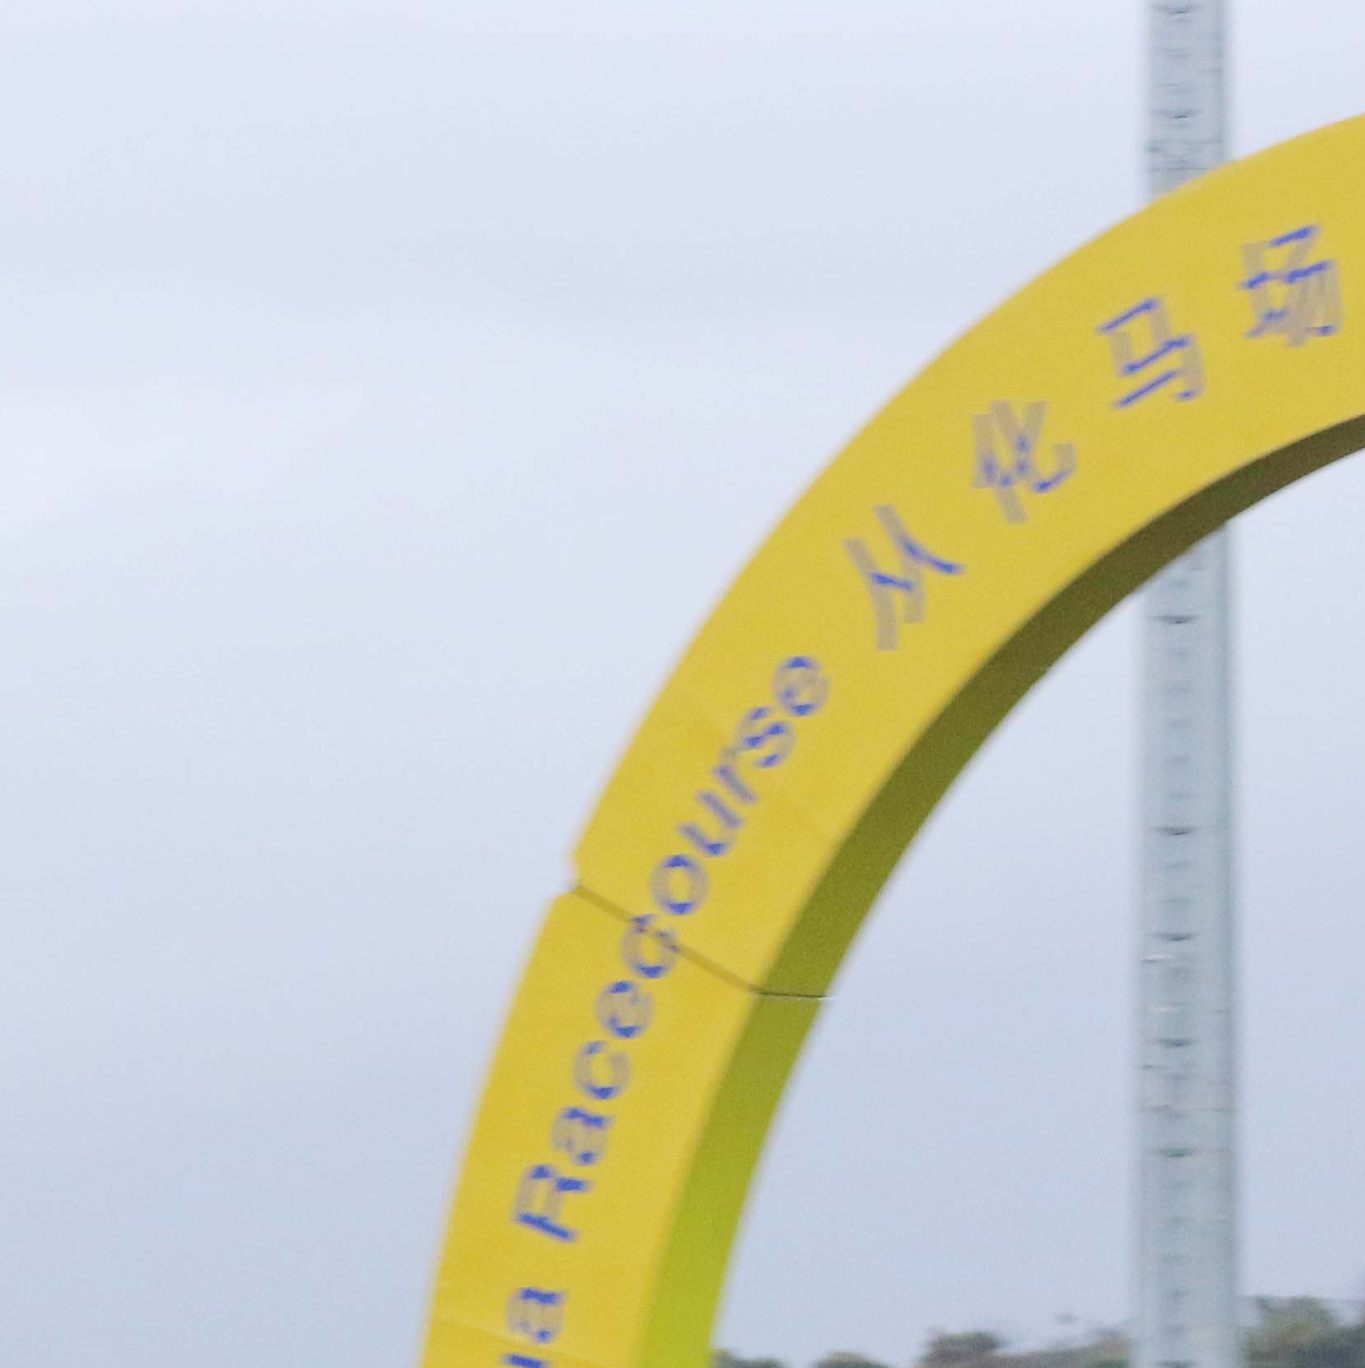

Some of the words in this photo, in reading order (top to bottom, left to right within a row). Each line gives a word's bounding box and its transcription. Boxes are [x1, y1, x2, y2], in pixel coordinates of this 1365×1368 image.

[843, 224, 1343, 650] 从化马场
[512, 654, 830, 1243] Racecourse
